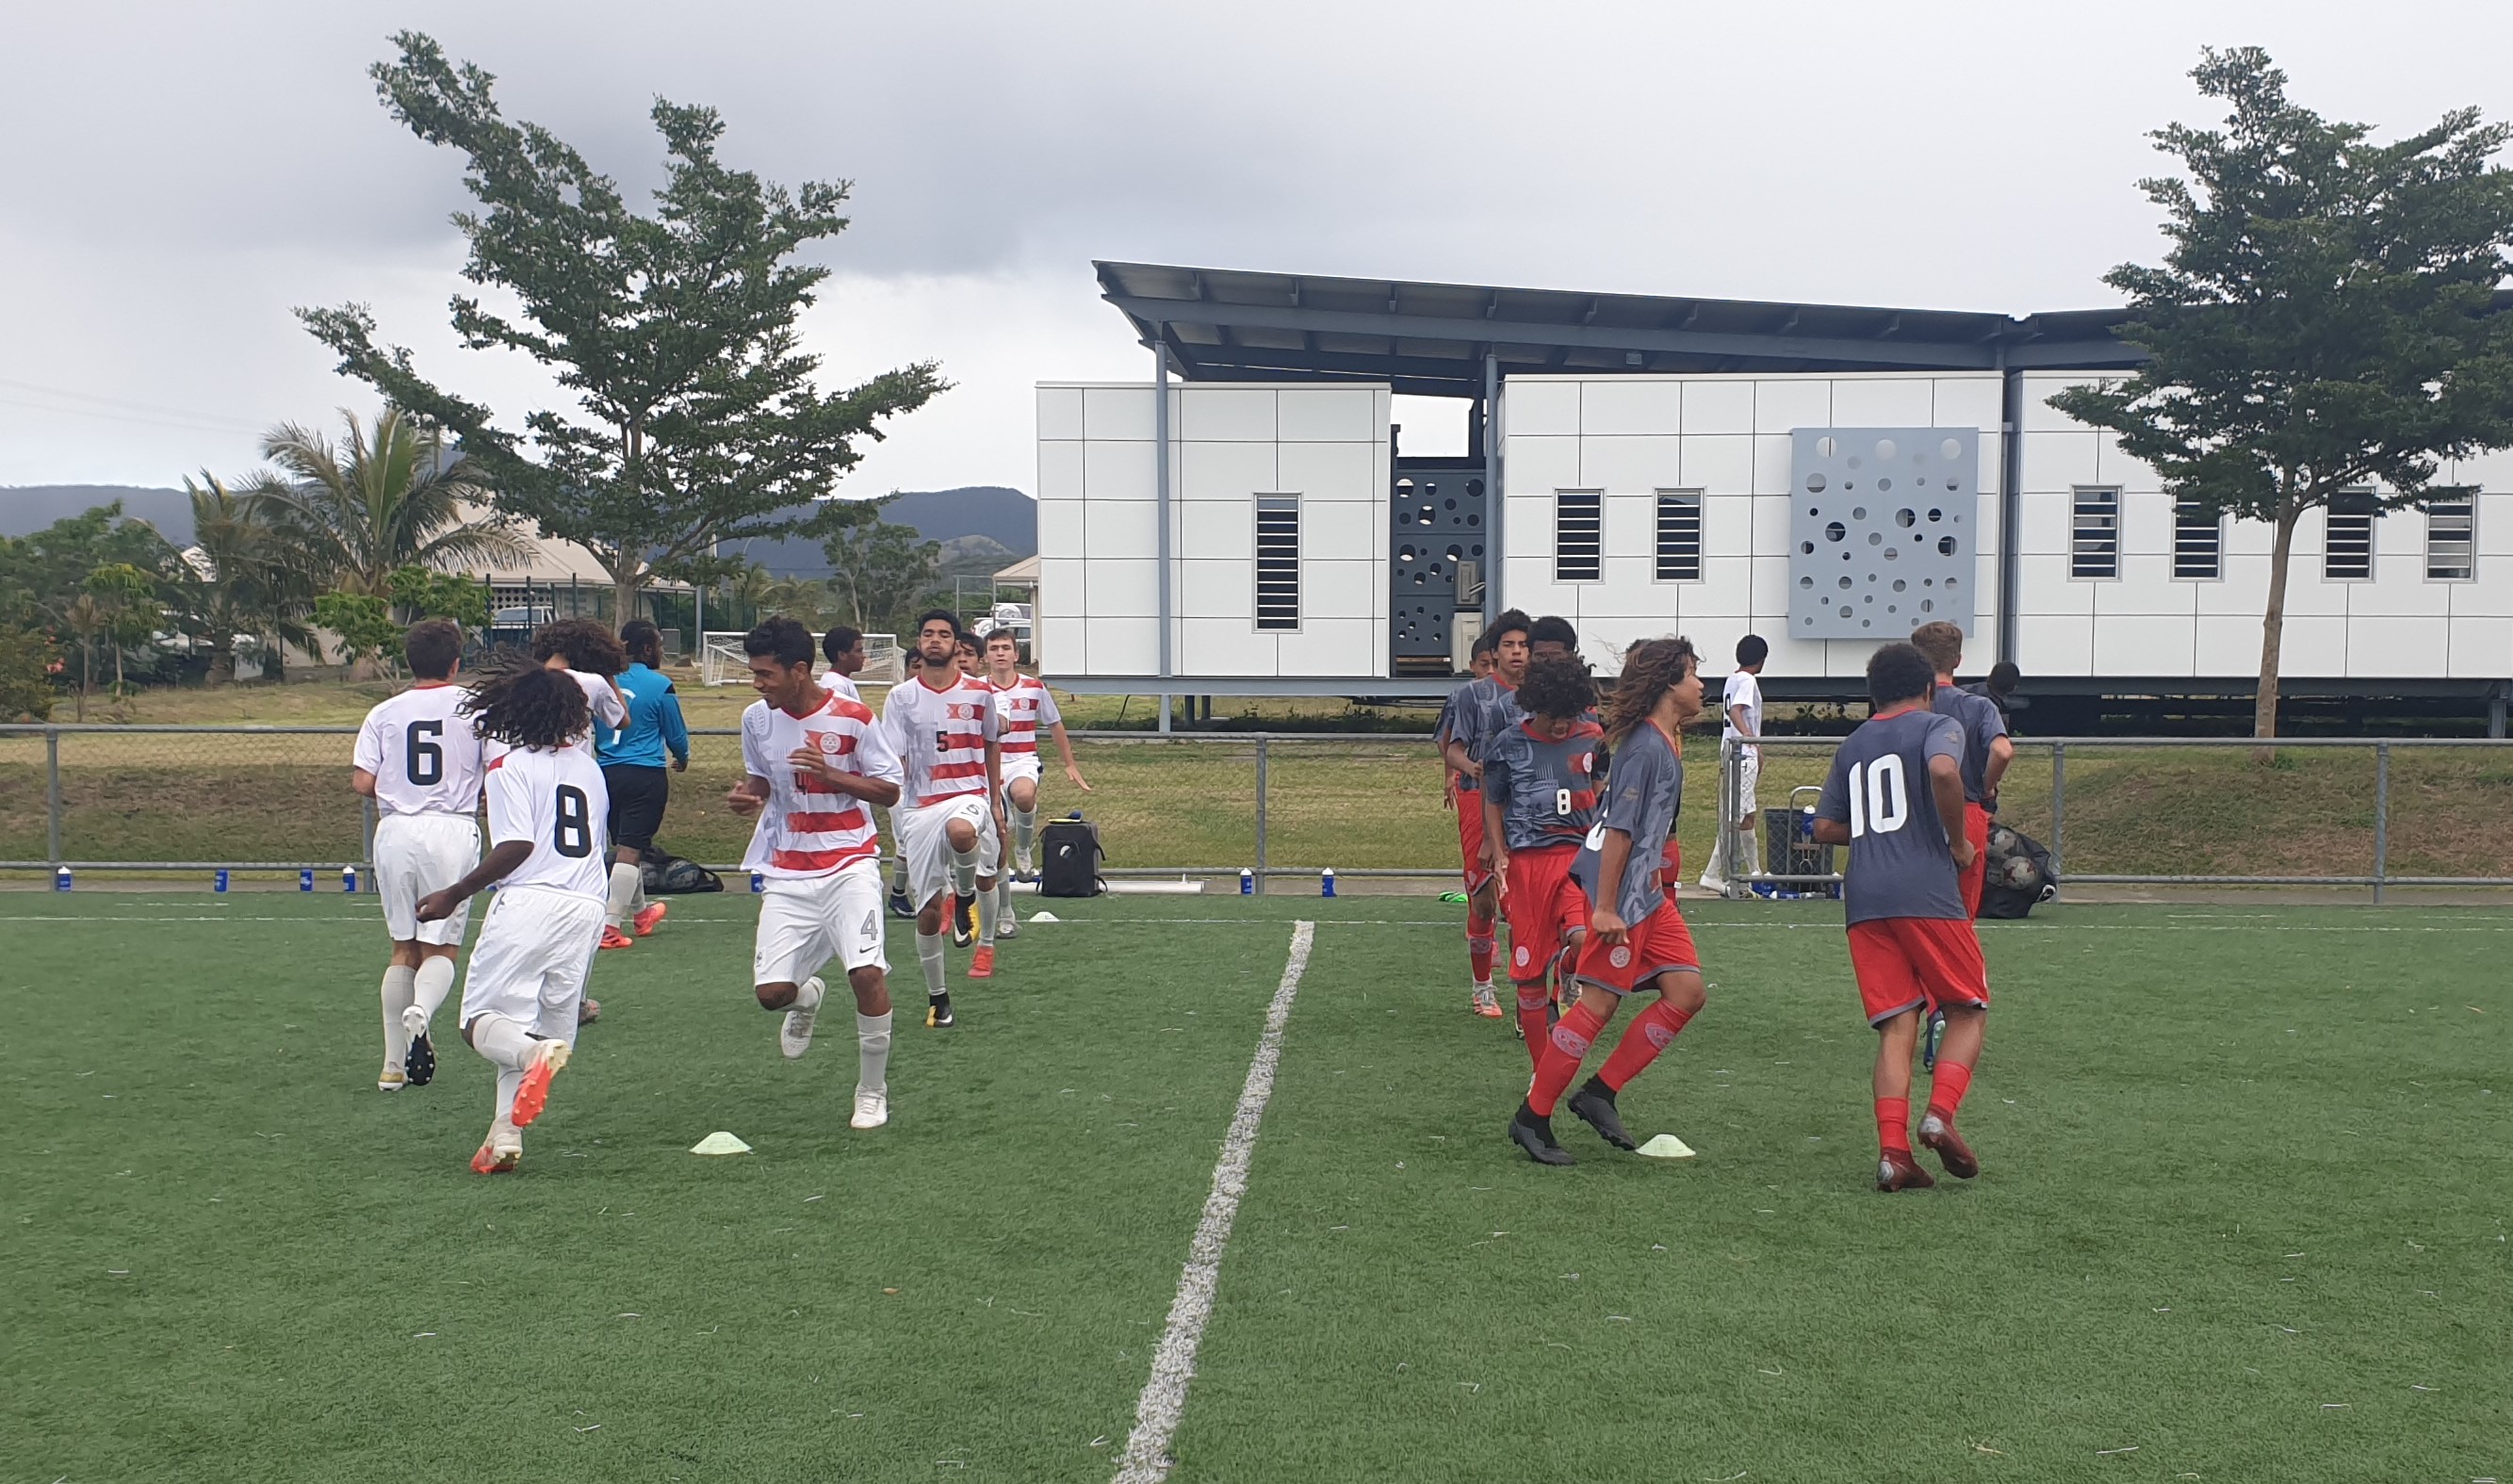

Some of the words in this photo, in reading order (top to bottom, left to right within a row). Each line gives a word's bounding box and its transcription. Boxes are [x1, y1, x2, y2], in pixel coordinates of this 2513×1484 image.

[407, 720, 443, 786] 6
[936, 730, 949, 752] 5
[1557, 789, 1571, 815] 8
[1849, 753, 1907, 839] 10
[554, 784, 592, 858] 8
[860, 909, 878, 940] 4
